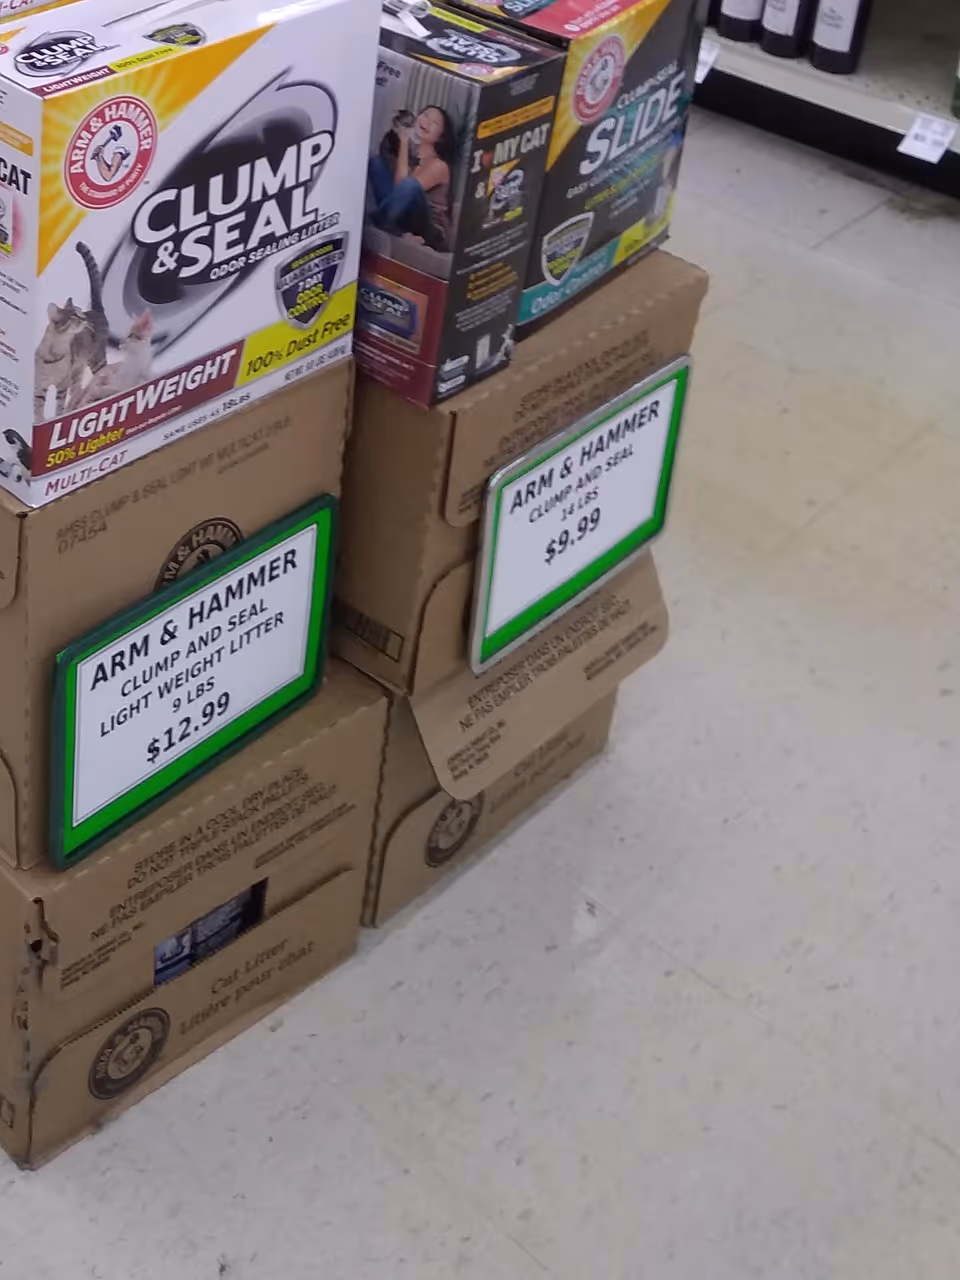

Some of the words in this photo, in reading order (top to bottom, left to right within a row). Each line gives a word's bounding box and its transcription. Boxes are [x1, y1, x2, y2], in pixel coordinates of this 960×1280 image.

[16, 35, 95, 64] CLUMP
[43, 68, 110, 93] LIGHTWEIGHT
[116, 57, 136, 69] 100%
[71, 130, 92, 174] ARM
[89, 116, 104, 132] &
[104, 102, 152, 151] HAMMER
[493, 135, 521, 164] MY
[520, 122, 551, 154] CAT
[579, 71, 686, 176] SLIDE
[134, 132, 333, 243] CLUMP
[210, 257, 246, 280] ODOR
[248, 233, 299, 264] SEALING
[300, 212, 341, 240] LITTER
[278, 250, 345, 291] GUARANTEED
[287, 291, 330, 319] CONTROL
[296, 284, 324, 303] ODOR
[298, 279, 305, 291] 7
[304, 272, 324, 288] DAY
[246, 350, 283, 377] 100%
[286, 331, 318, 359] Dust
[320, 313, 351, 340] Free
[49, 348, 237, 451] LIGHTWEIGHT
[45, 450, 129, 496] MULTI-CAT
[46, 446, 76, 468] 50%
[78, 426, 125, 456] Lighter
[510, 467, 555, 514] ARM
[560, 456, 574, 479] &
[579, 399, 661, 466] HAMMER
[528, 485, 572, 523] CLUMP
[575, 465, 602, 492] AND
[605, 444, 634, 472] SEAL
[577, 486, 599, 510] LBS
[544, 507, 601, 565] $9.99
[91, 634, 150, 690] ARM
[160, 619, 178, 646] &
[188, 548, 297, 630] HAMMER
[121, 651, 181, 697] CLUMP
[185, 625, 222, 658] AND
[227, 598, 268, 632] SEAL
[100, 692, 152, 737] LIGHT
[157, 647, 225, 700] WEIGHT
[229, 611, 285, 655] LITTER
[172, 697, 181, 713] 9
[187, 676, 216, 704] LBS
[146, 692, 230, 763] $12.99
